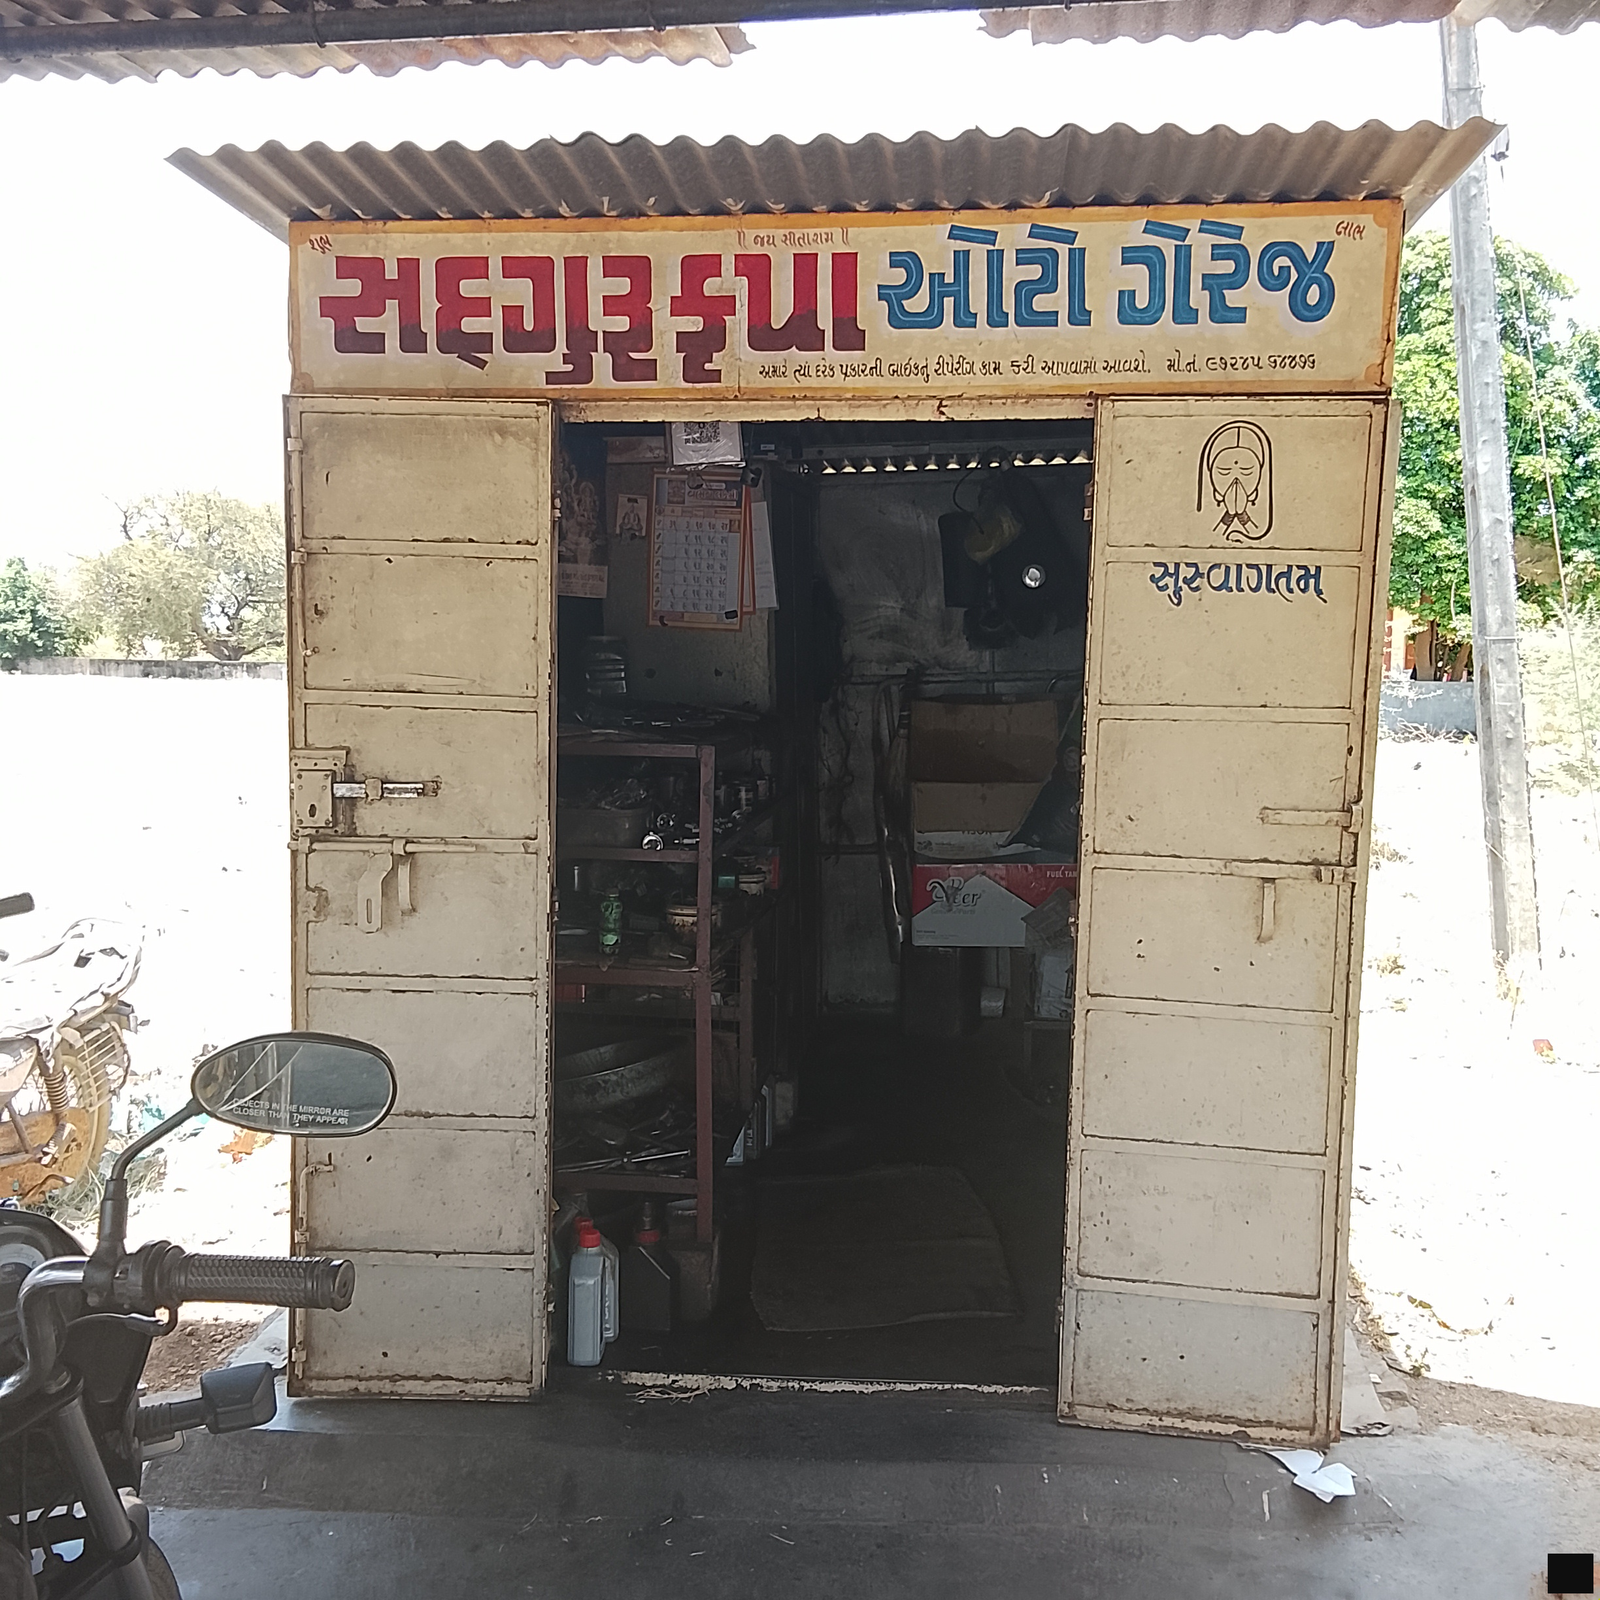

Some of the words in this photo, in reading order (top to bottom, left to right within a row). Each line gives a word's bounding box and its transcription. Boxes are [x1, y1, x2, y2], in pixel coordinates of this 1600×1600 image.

[1335, 220, 1366, 241] લાભ
[308, 234, 333, 255] શુભ
[753, 234, 777, 248] જય
[877, 222, 1092, 331] ઓટો
[1116, 219, 1336, 326] ગેરેજ
[758, 358, 789, 379] અમારે
[793, 360, 813, 384] ત્યાં
[815, 357, 836, 378] દરેક
[839, 356, 884, 382] પ્રકારની
[978, 360, 1004, 376] કામ
[1010, 354, 1037, 375] કરી
[1040, 355, 1099, 376] આપવામાં
[1205, 355, 1264, 371] ૯૭૨૪૫
[1267, 354, 1316, 370] ૬૪૪૭૬
[1046, 870, 1063, 878] FUEL
[233, 1107, 266, 1117] CLOSER
[293, 1113, 314, 1122] THEY
[315, 1115, 349, 1125] APPEAR
[271, 1102, 280, 1111] IN
[300, 1105, 331, 1116] MIRROR
[332, 1108, 350, 1117] ARE
